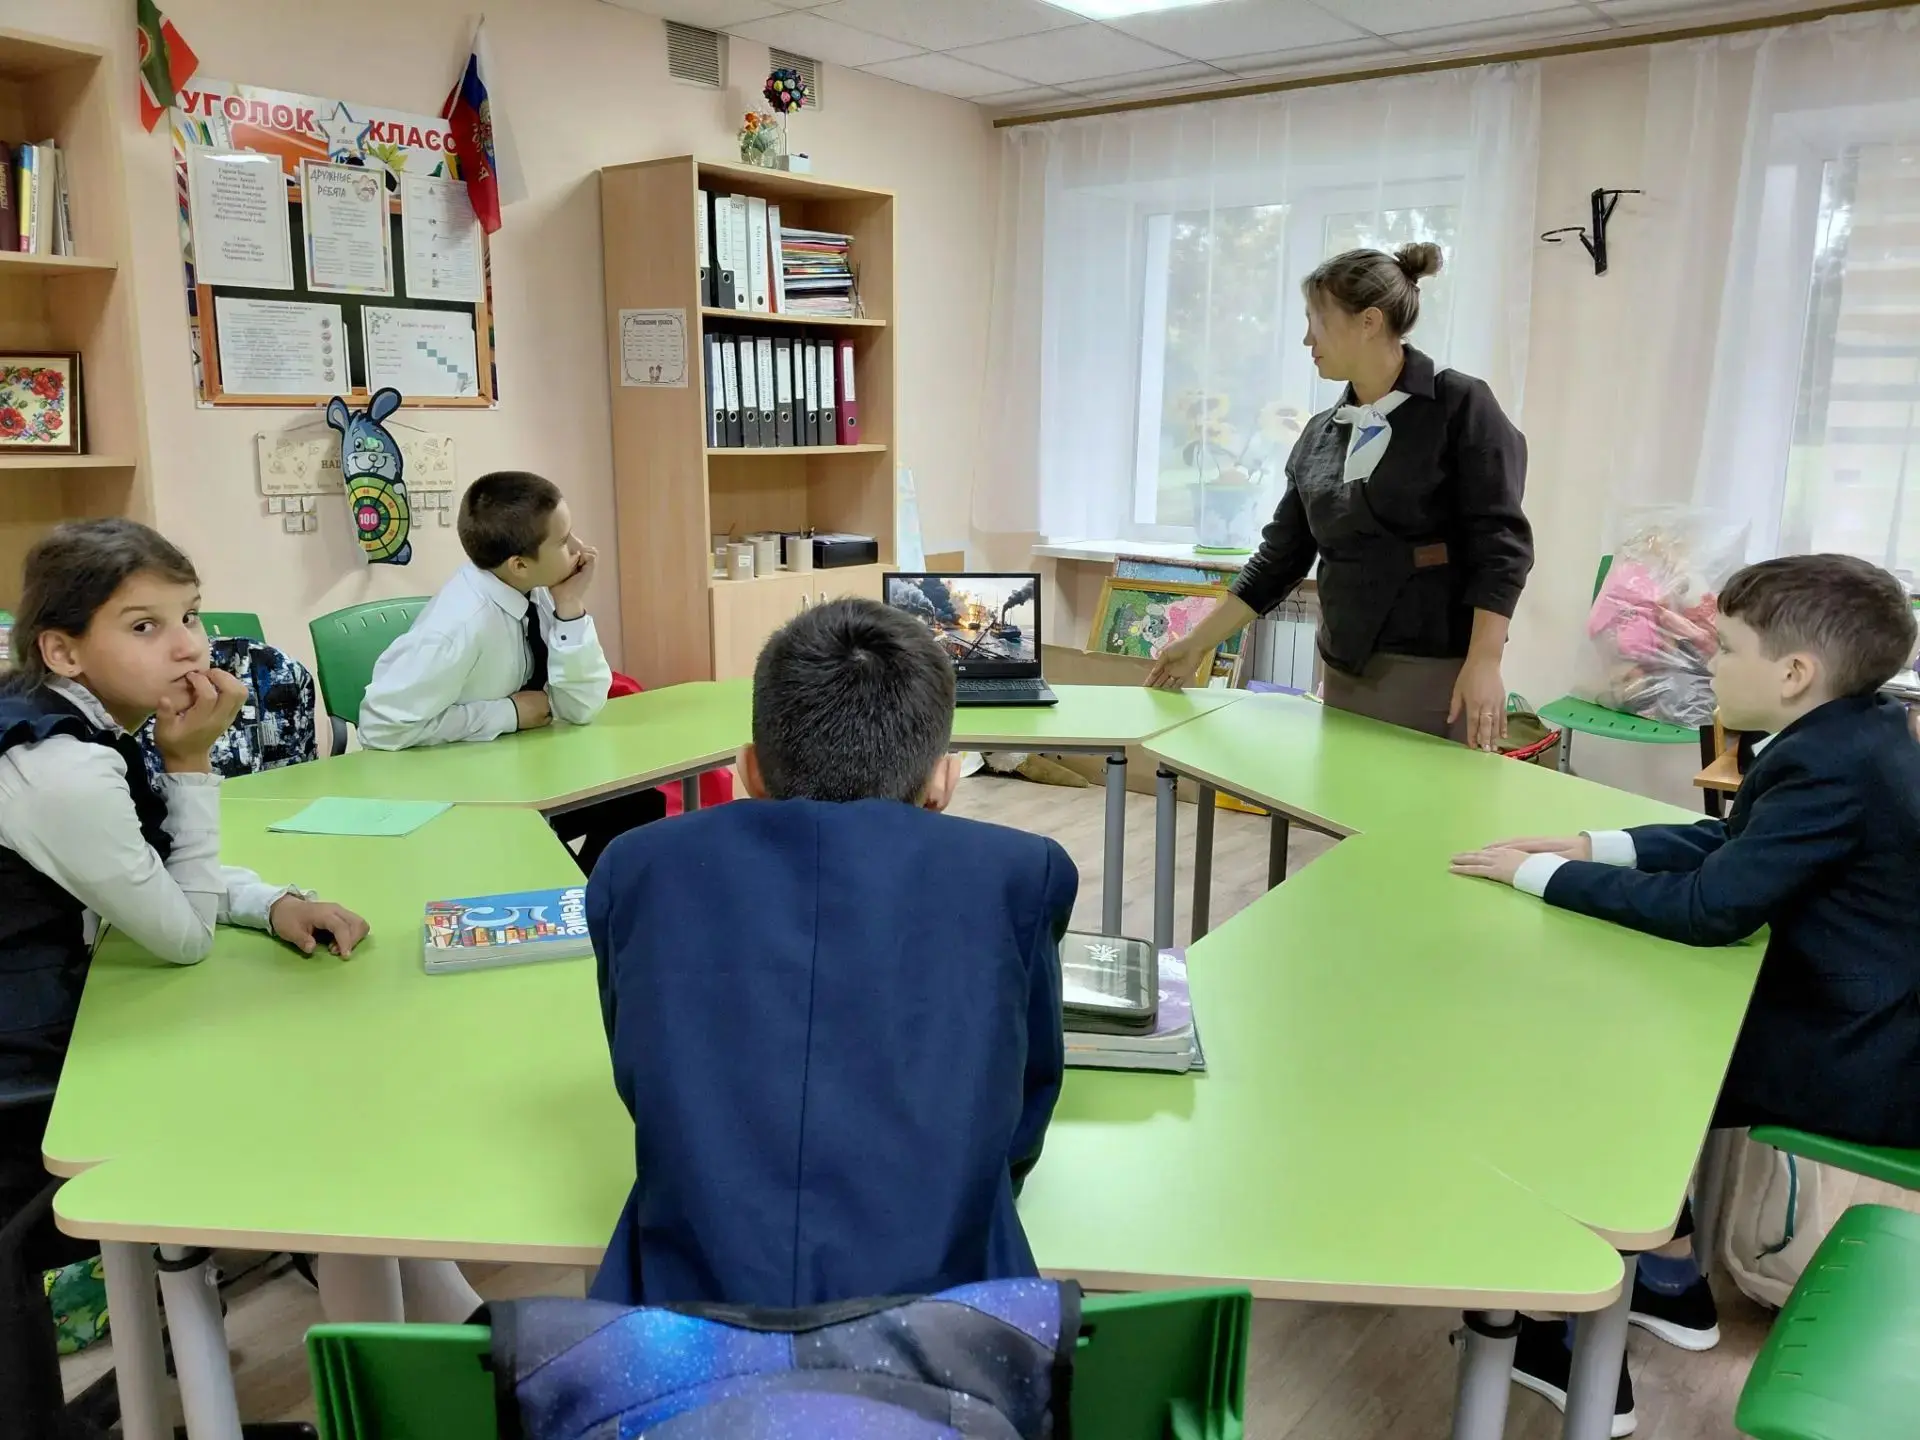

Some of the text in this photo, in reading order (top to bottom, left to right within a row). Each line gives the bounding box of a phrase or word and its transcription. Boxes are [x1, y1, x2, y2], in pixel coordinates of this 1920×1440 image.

[181, 89, 315, 132] УГОЛОК
[310, 168, 352, 183] ДРУЖНЫЕ
[317, 185, 346, 198] РЕБЯТА
[359, 513, 379, 525] 100
